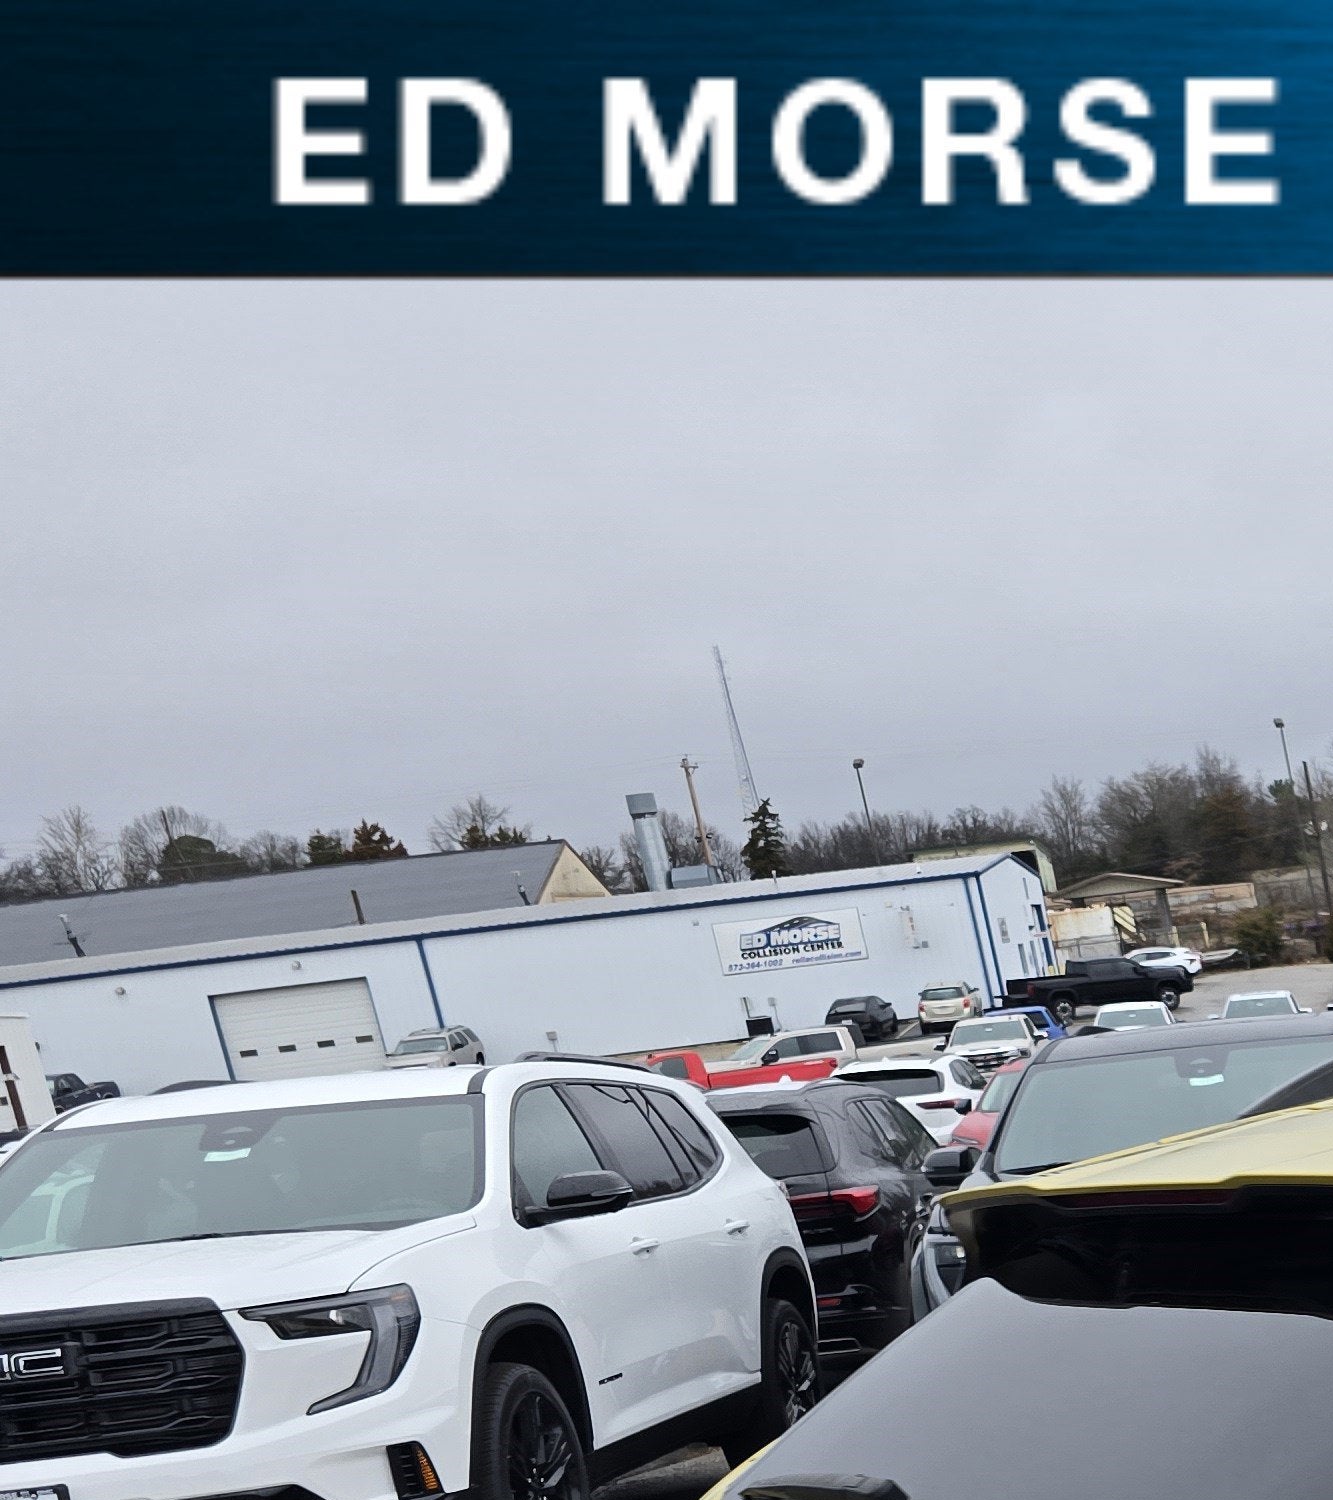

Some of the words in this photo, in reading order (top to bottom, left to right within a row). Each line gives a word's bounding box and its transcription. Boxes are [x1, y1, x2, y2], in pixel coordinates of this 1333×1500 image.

[740, 931, 768, 951] ED
[769, 924, 841, 946] MORSE
[741, 944, 801, 960] COLLISION
[804, 941, 845, 953] CENTER
